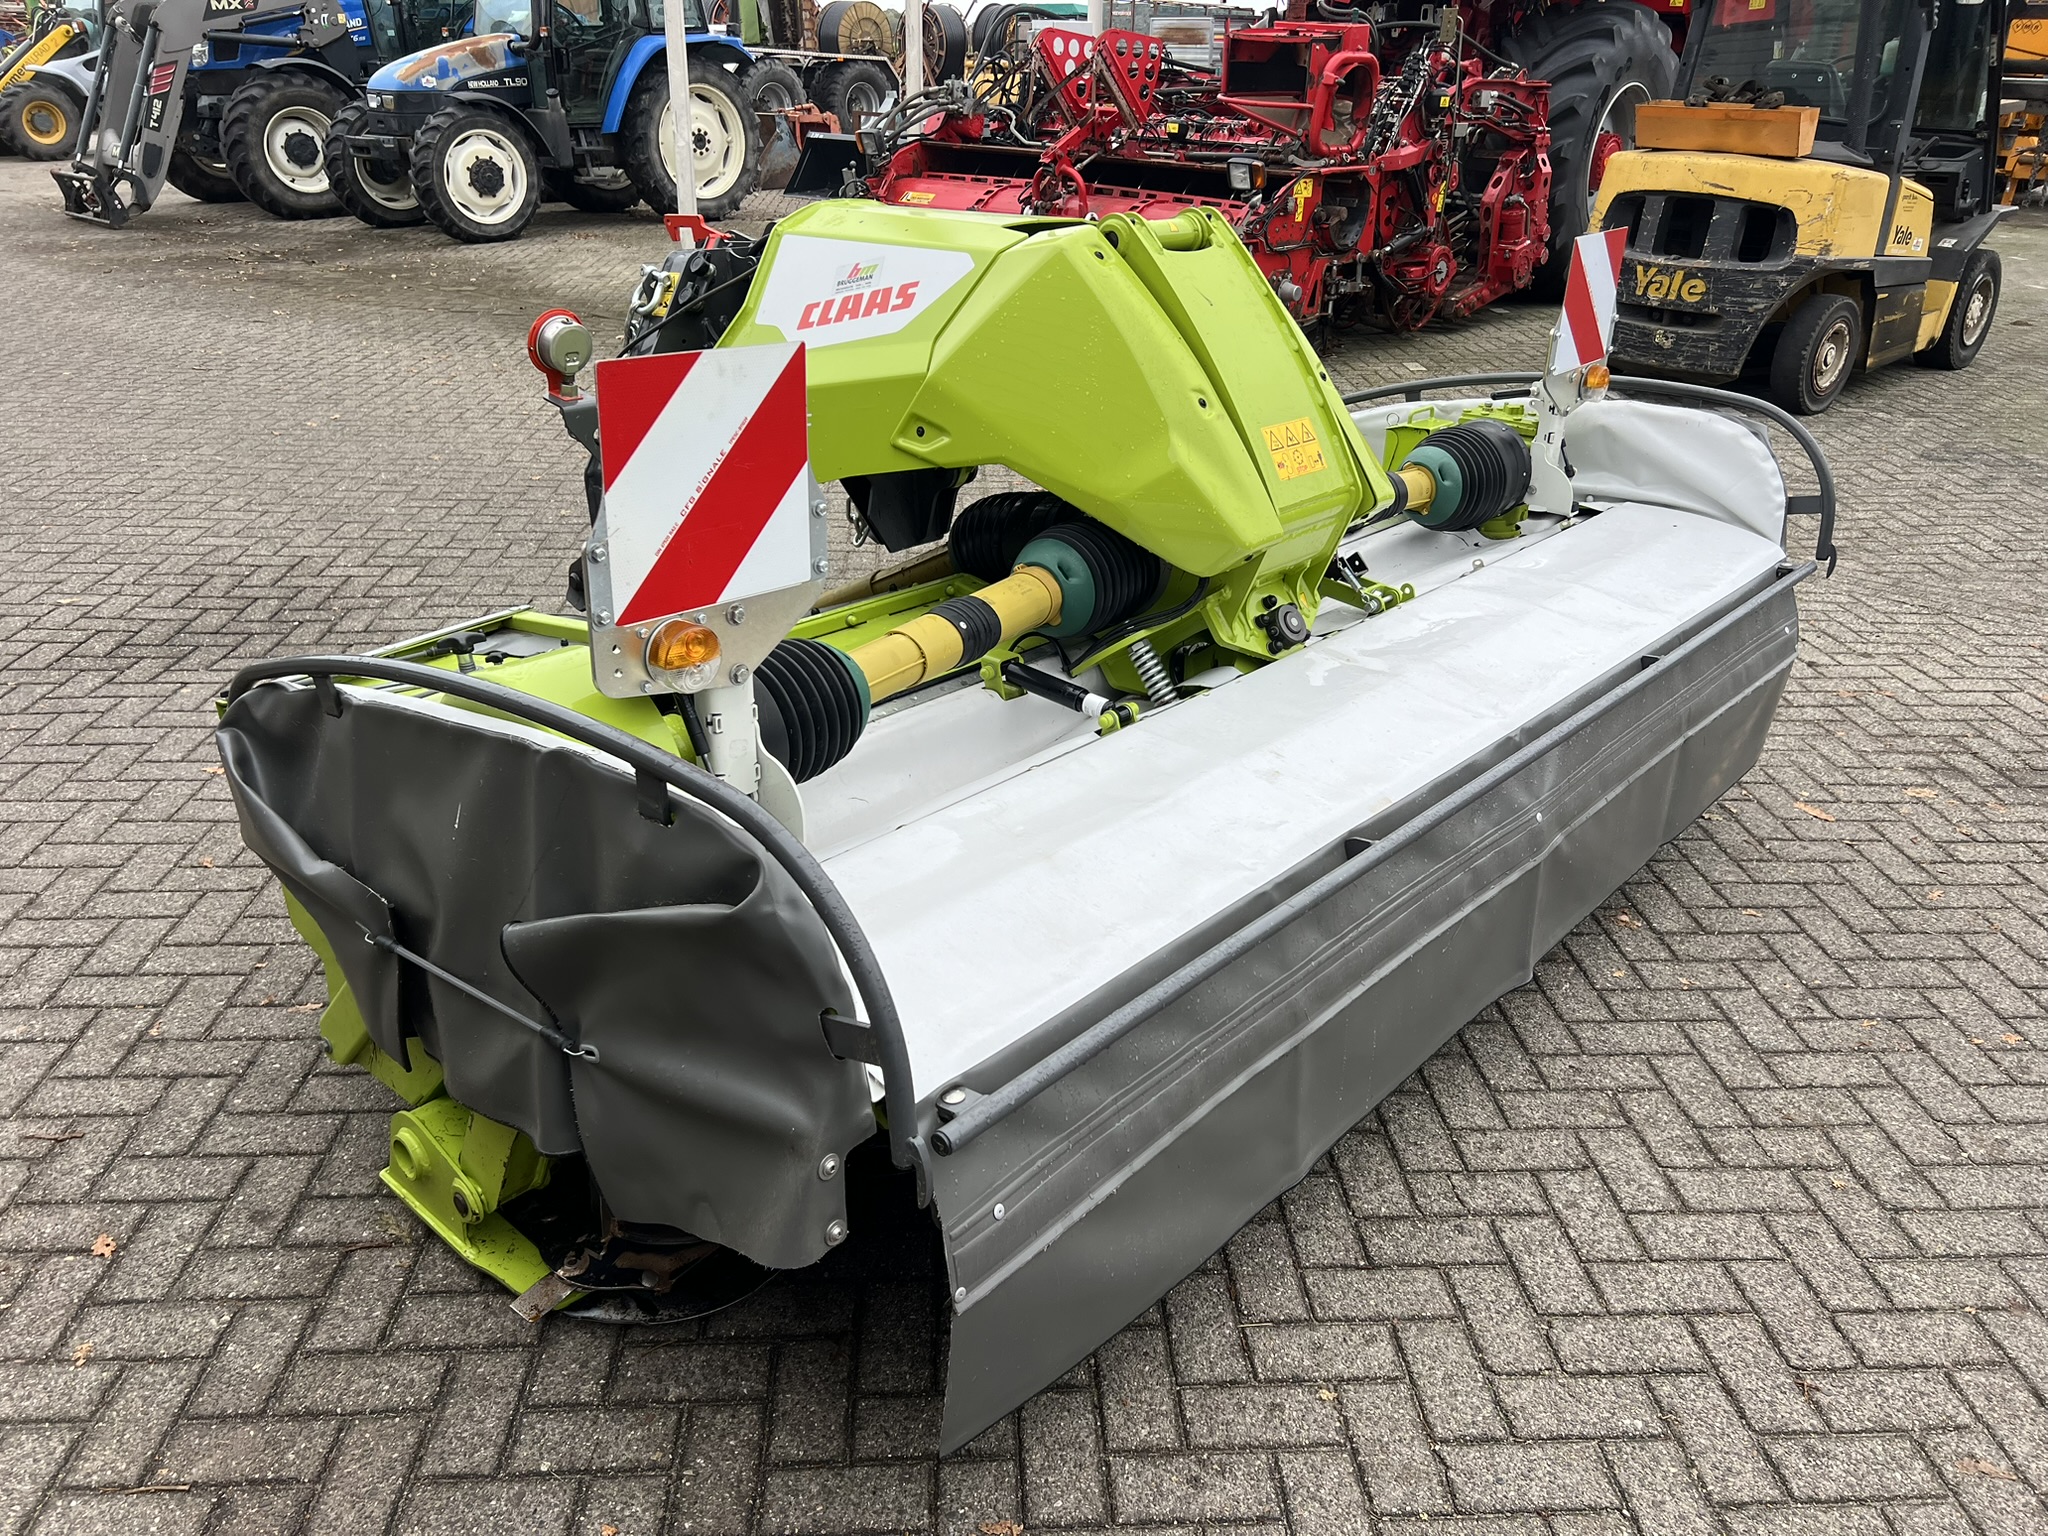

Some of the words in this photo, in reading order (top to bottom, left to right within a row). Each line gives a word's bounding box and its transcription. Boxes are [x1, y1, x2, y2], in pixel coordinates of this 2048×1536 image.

[210, 0, 244, 10] MX
[503, 77, 528, 87] TL90
[1892, 225, 1913, 246] Yale
[1635, 264, 1708, 303] Yale
[796, 280, 921, 331] CLAAS
